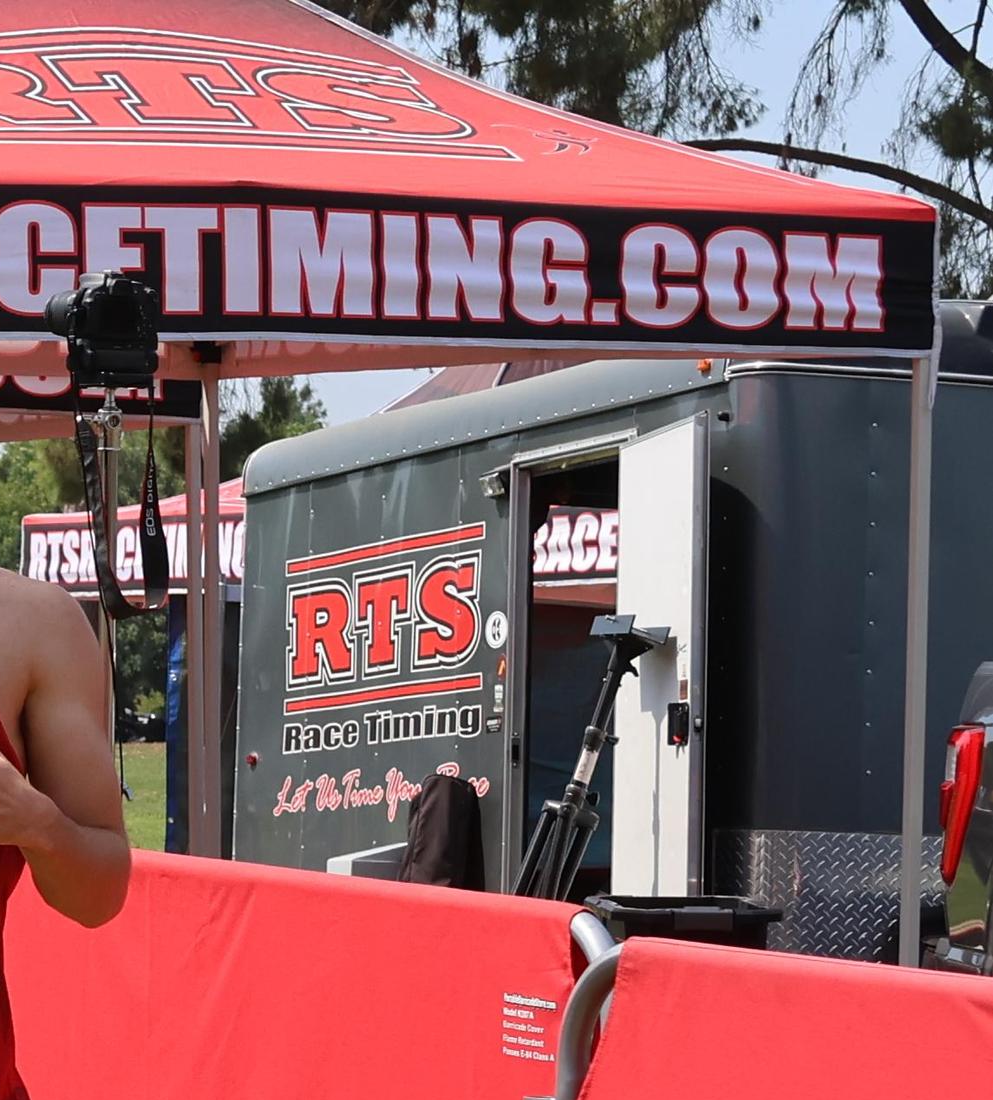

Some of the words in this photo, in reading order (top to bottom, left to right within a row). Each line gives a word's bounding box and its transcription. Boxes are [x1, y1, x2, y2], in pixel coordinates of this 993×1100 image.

[145, 508, 156, 536] EOS
[286, 549, 482, 691] RTS
[282, 720, 359, 755] Race
[364, 704, 482, 744] Timing
[273, 776, 313, 816] Let
[316, 774, 342, 811] Us
[342, 768, 383, 809] Time
[385, 767, 422, 822] You
